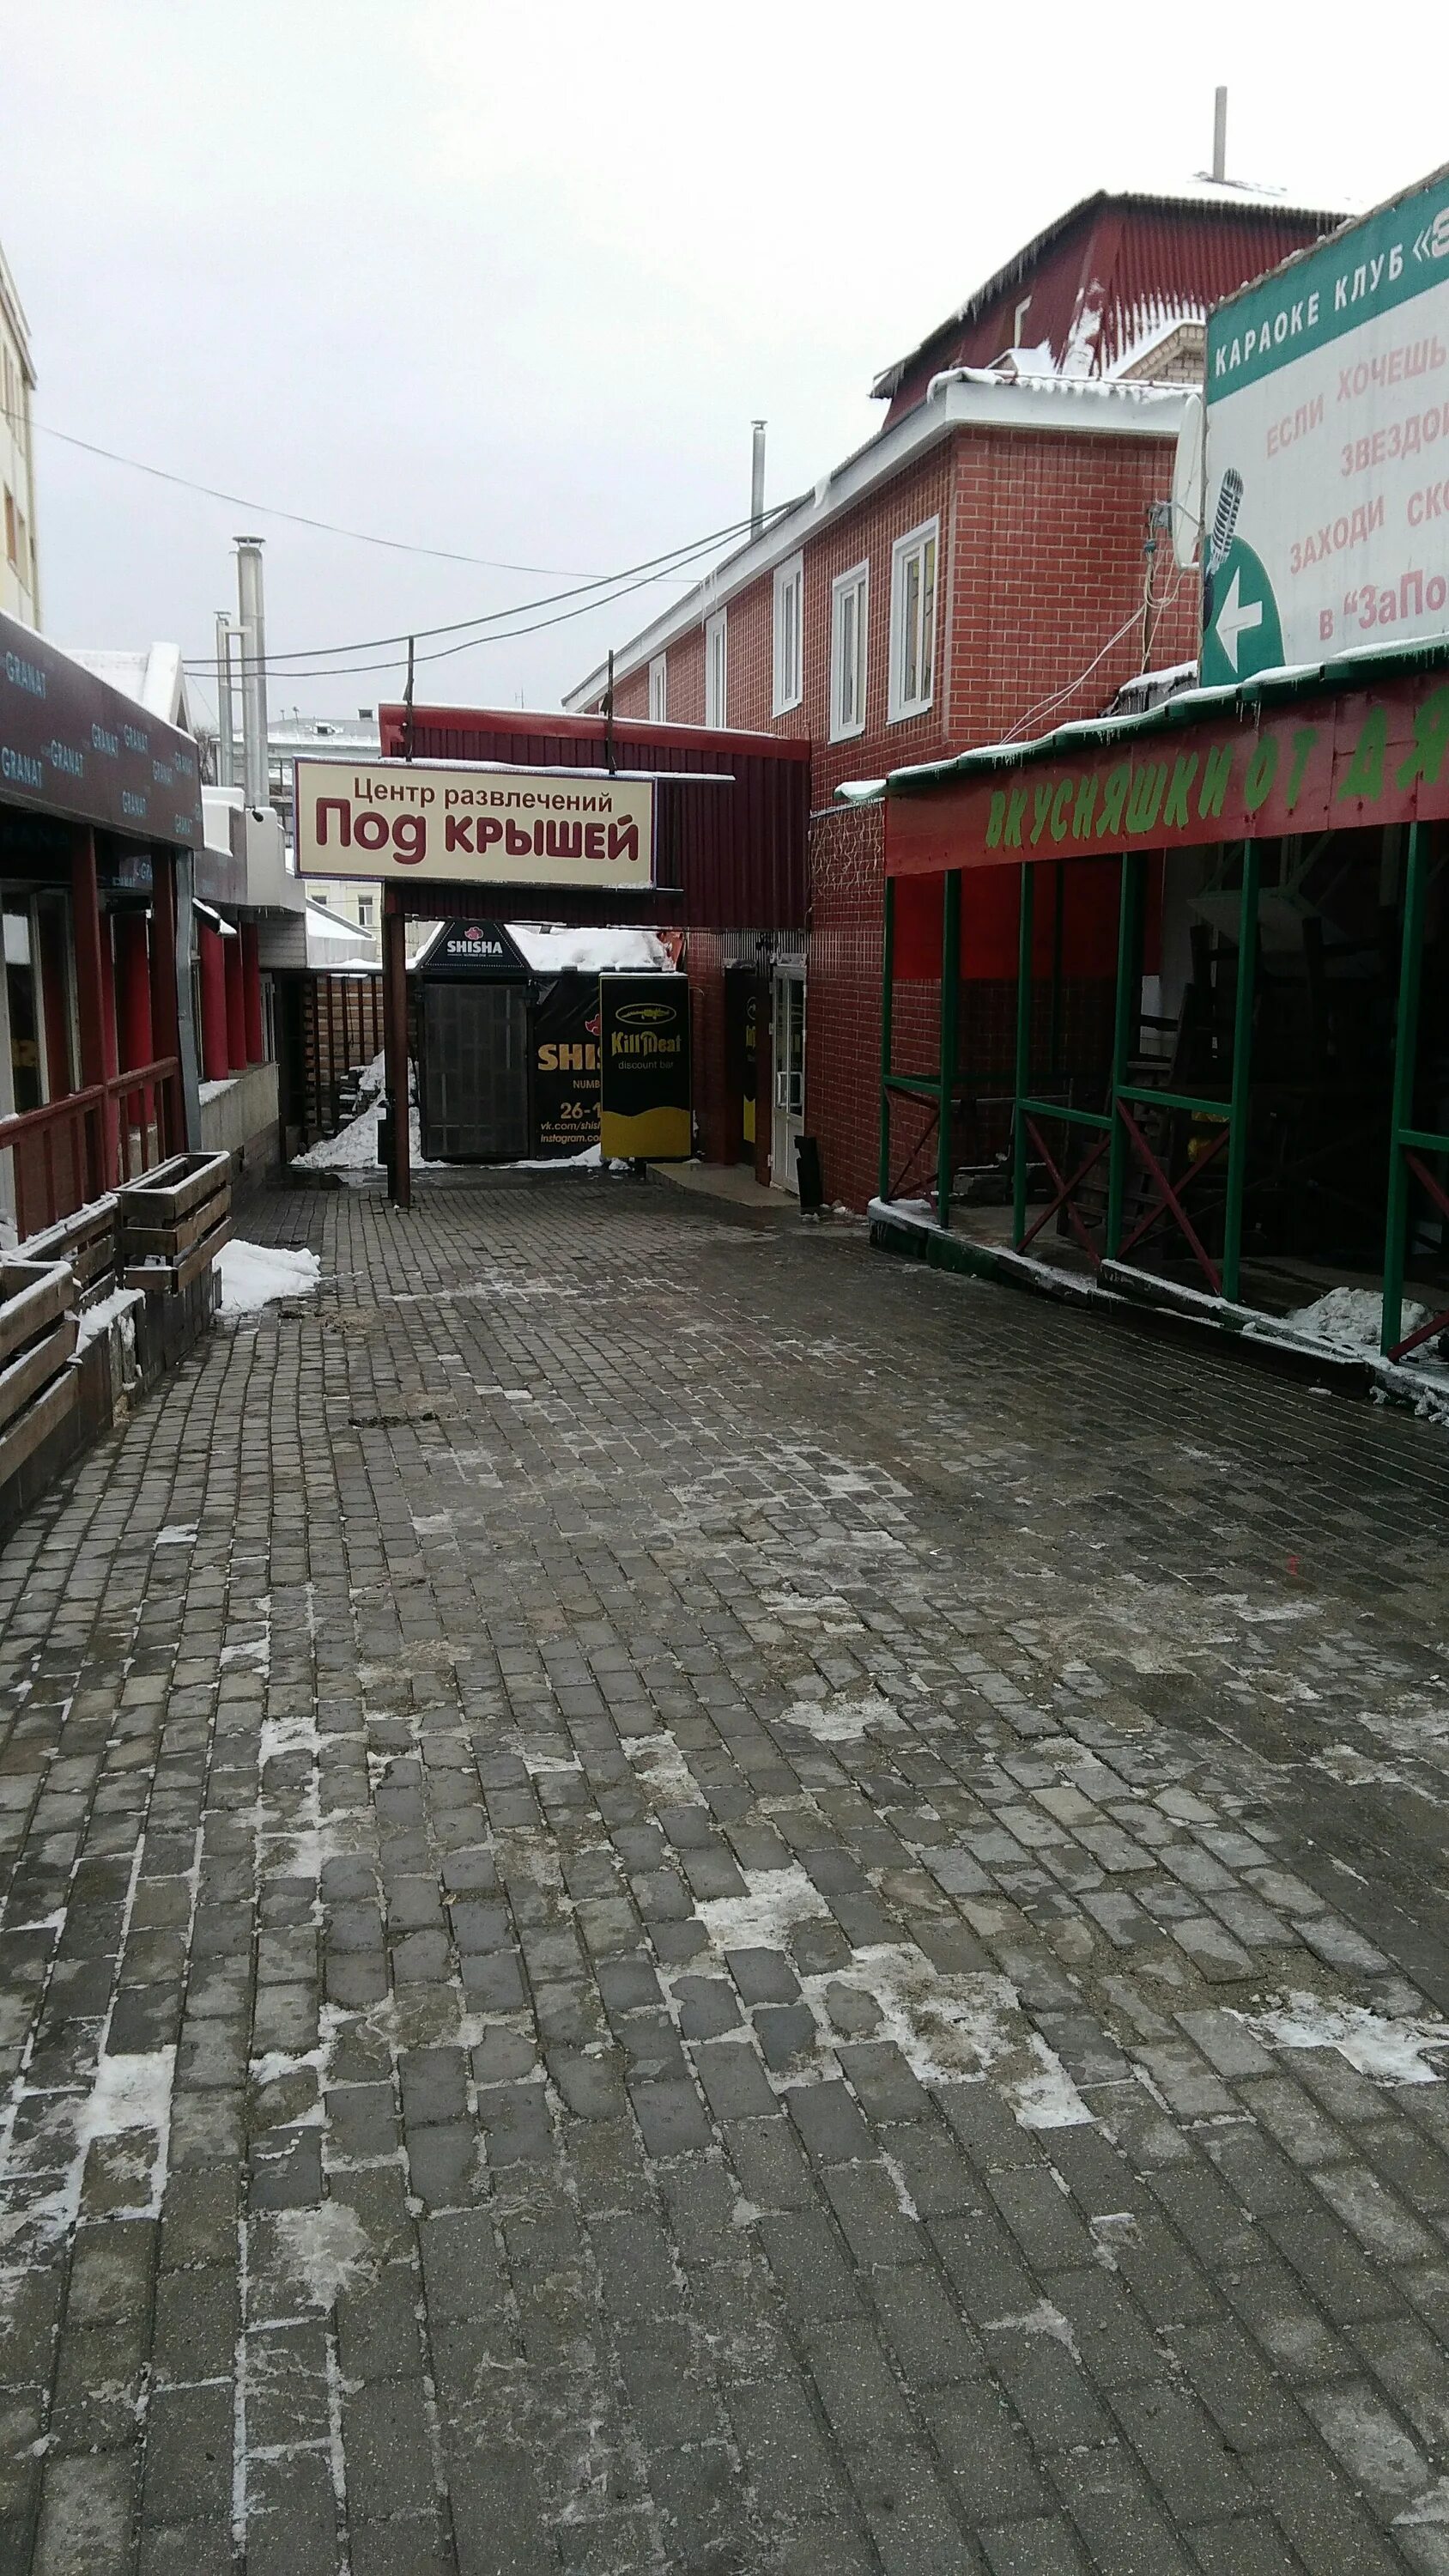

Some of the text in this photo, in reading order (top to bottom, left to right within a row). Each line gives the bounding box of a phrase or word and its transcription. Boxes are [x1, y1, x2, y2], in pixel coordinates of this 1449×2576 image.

[1215, 290, 1319, 378] КАРАОКЕ
[1335, 244, 1404, 311] КЛУБ
[1266, 336, 1446, 459] ЕСЛИ ХОЧЕШЬ
[1290, 495, 1385, 574] ЗАХОДИ
[5, 650, 46, 700] GRANAT
[2, 746, 43, 789] GRANAT
[985, 744, 1234, 848] ВКУСНЯШКИ
[1245, 728, 1319, 810] ОТ
[354, 777, 613, 813] Центр развлечений
[316, 797, 640, 865] Под КРЫШЕЙ
[447, 940, 503, 954] SHISHA
[537, 1043, 601, 1071] SHI
[618, 1060, 658, 1070] discount
